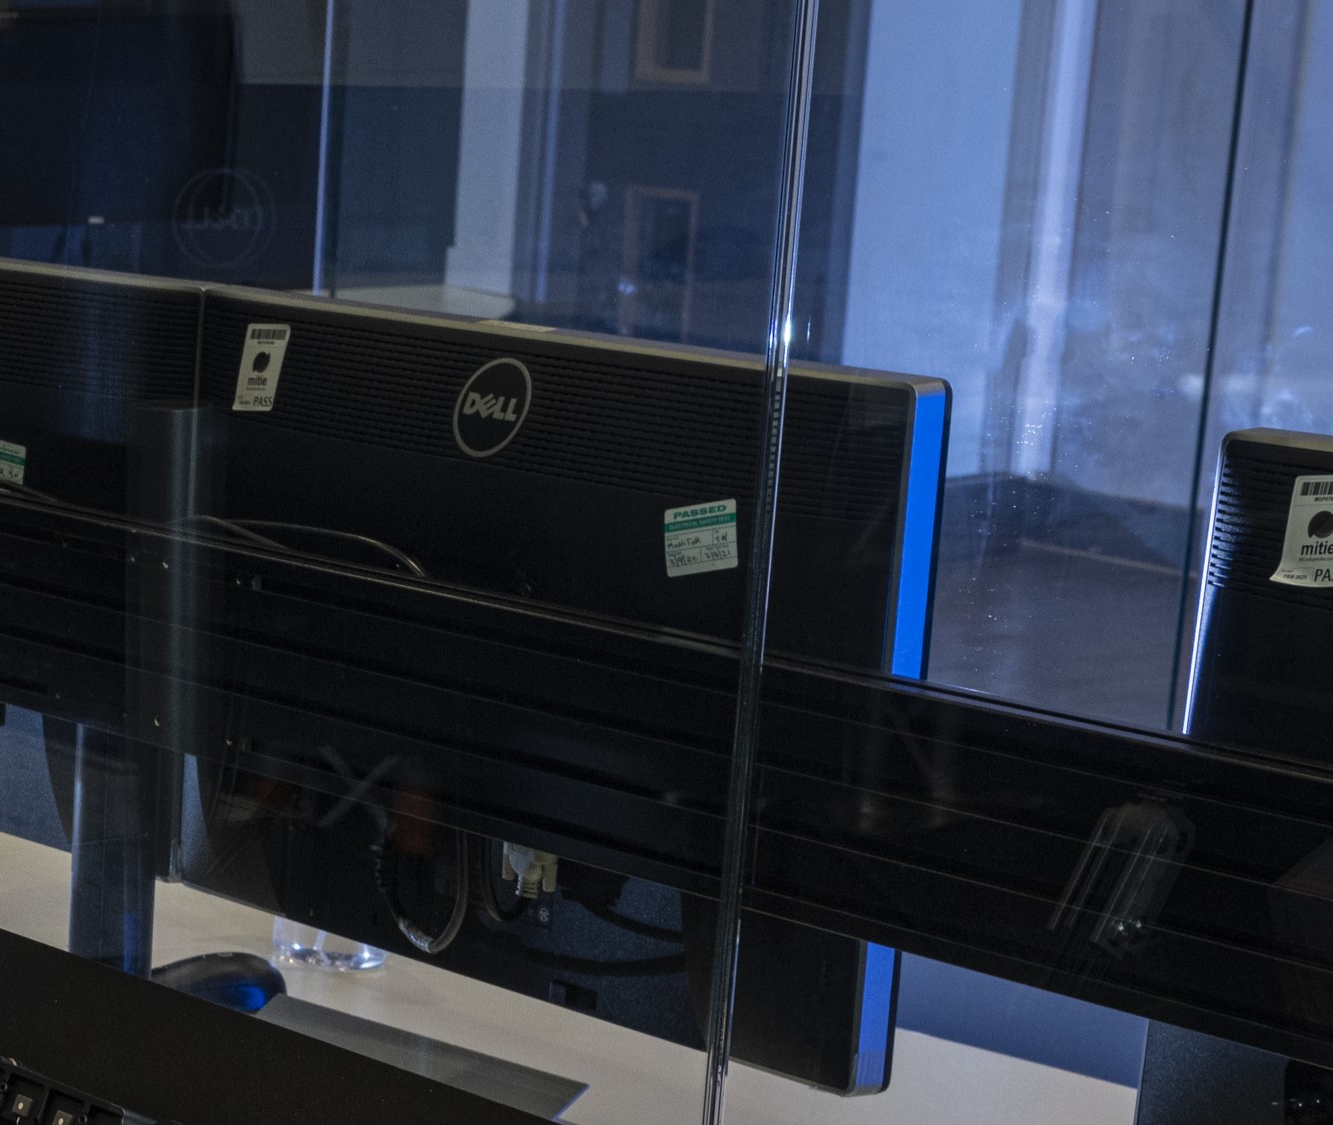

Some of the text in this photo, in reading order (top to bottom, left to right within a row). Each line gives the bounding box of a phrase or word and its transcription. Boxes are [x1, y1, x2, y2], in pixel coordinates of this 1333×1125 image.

[247, 375, 267, 386] mitie
[253, 395, 273, 407] PASS
[462, 391, 518, 422] DELL
[674, 505, 726, 520] PASSED
[1313, 568, 1333, 582] PA
